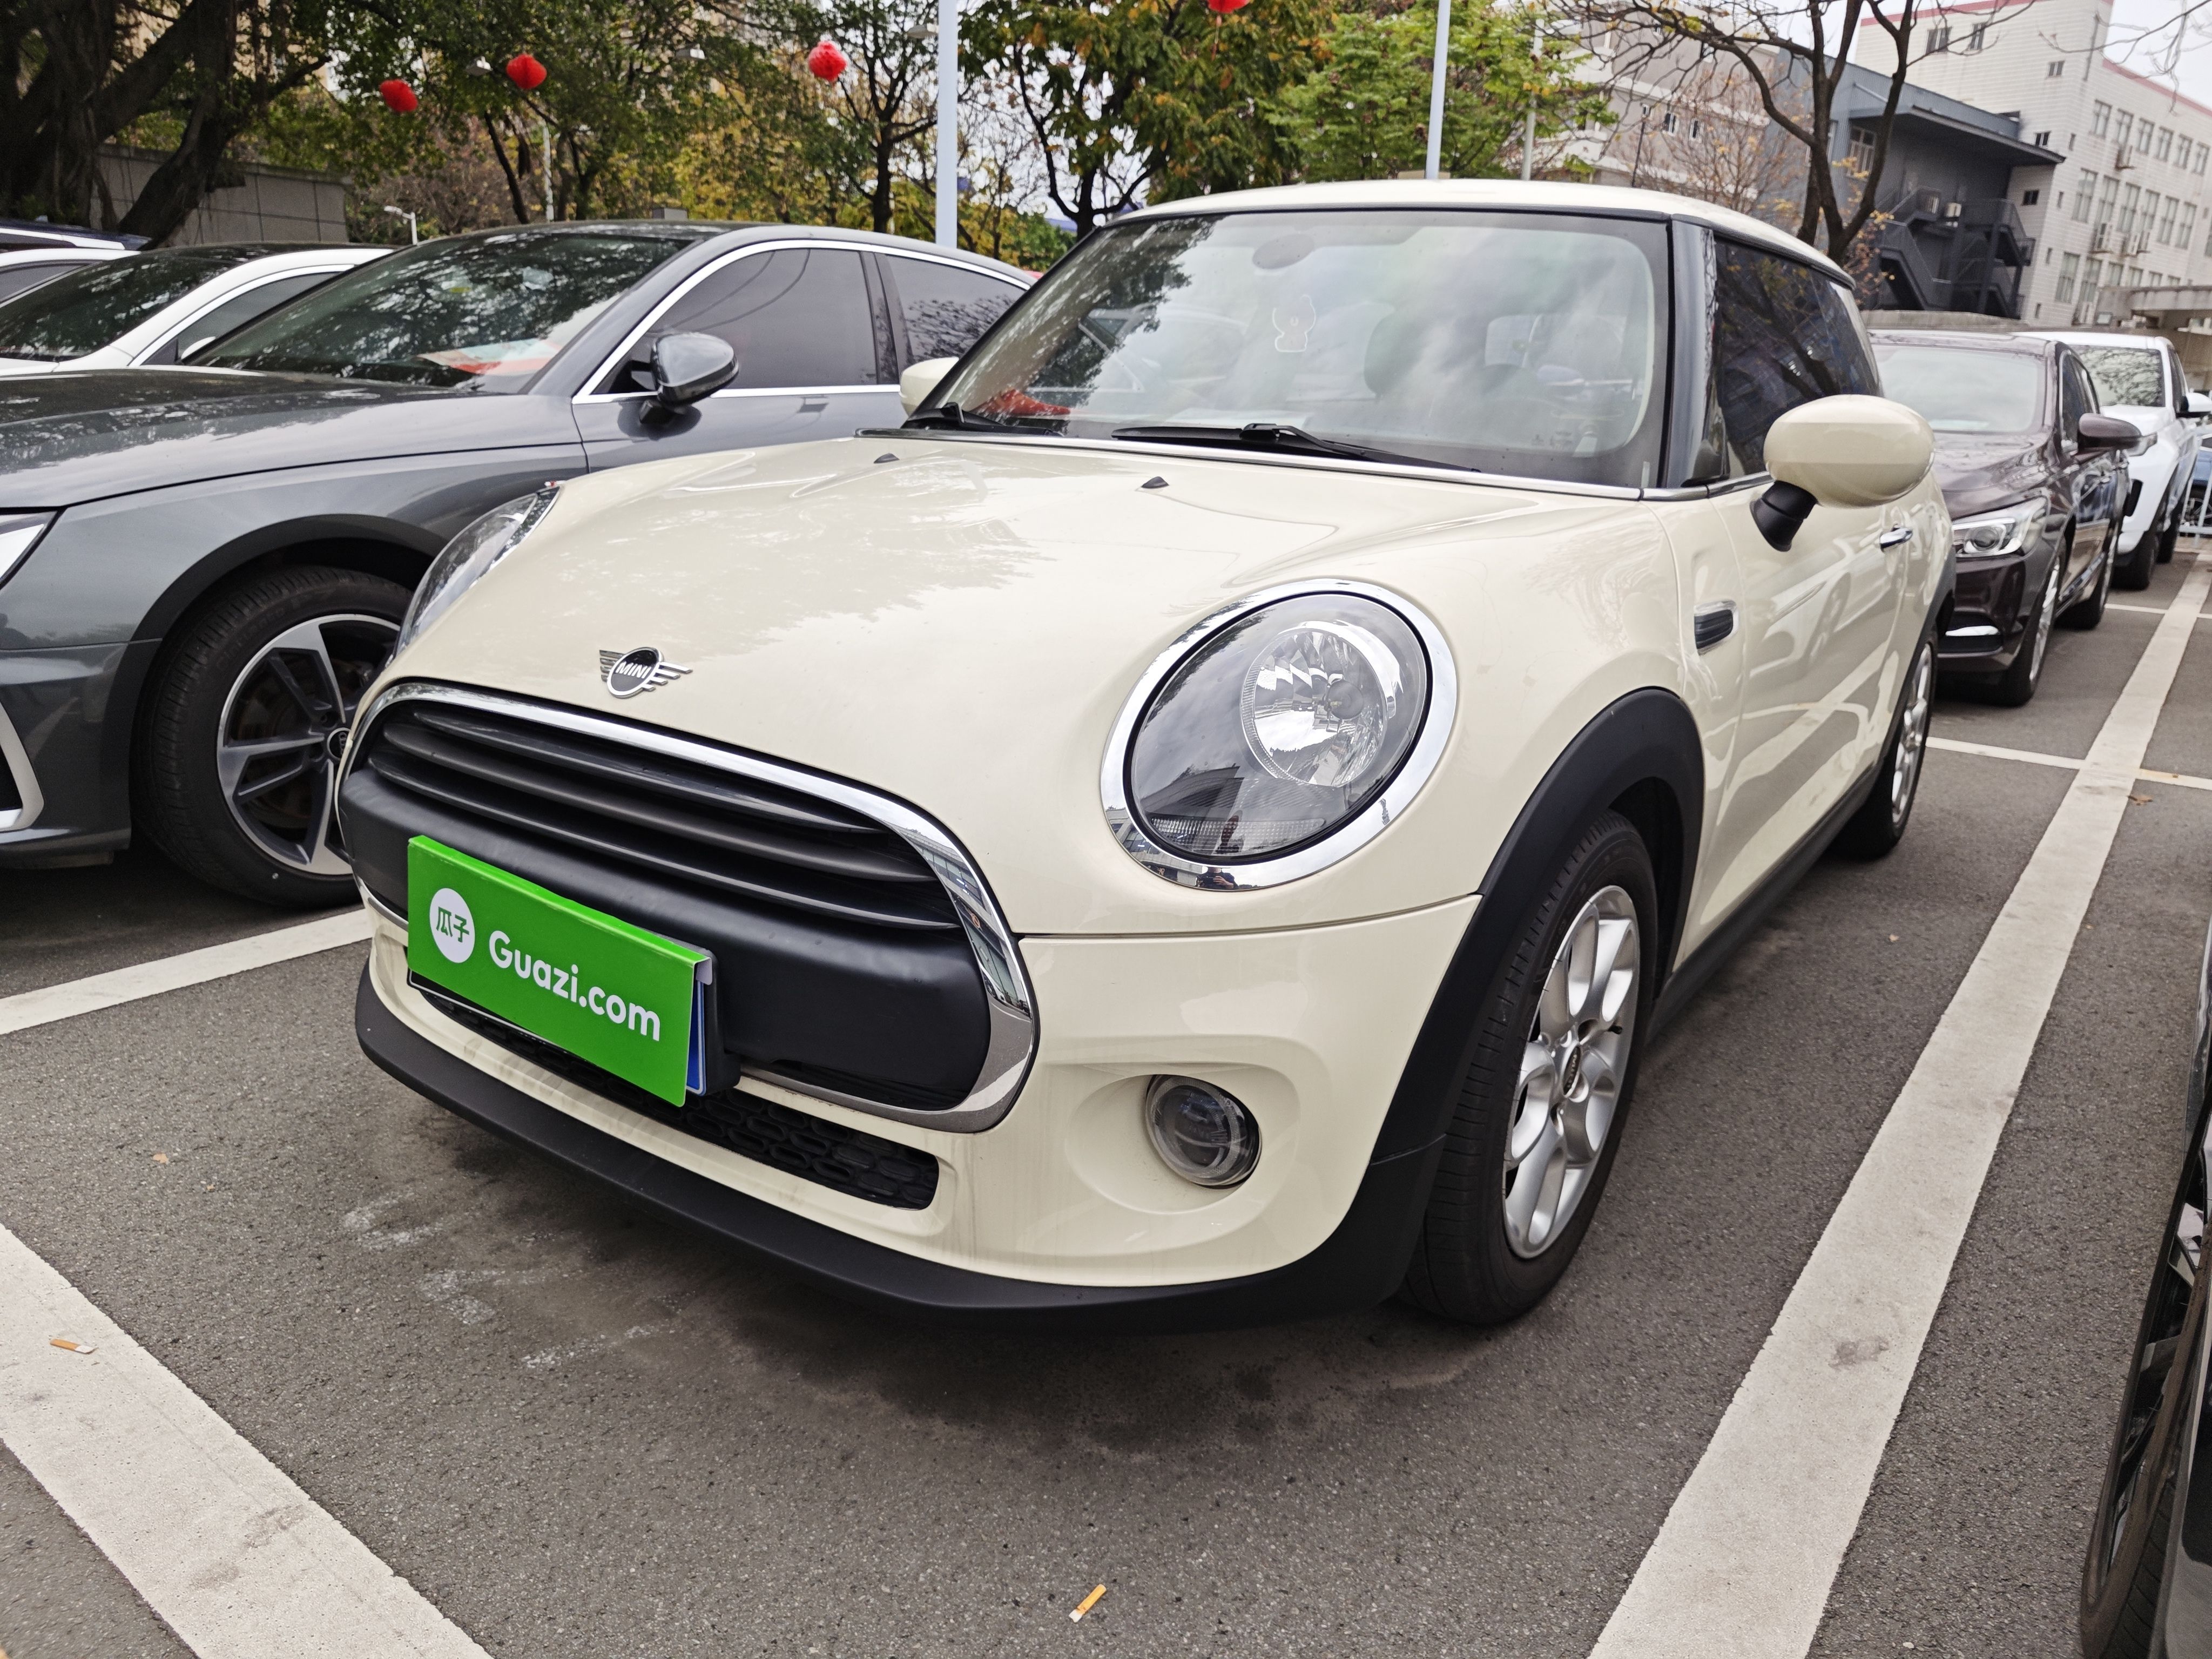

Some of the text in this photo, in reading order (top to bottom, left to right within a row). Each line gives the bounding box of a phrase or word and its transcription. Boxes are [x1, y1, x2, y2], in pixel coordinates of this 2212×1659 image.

[615, 661, 652, 679] MINI
[436, 906, 470, 943] 瓜子
[489, 930, 661, 1042] Guazi.com
